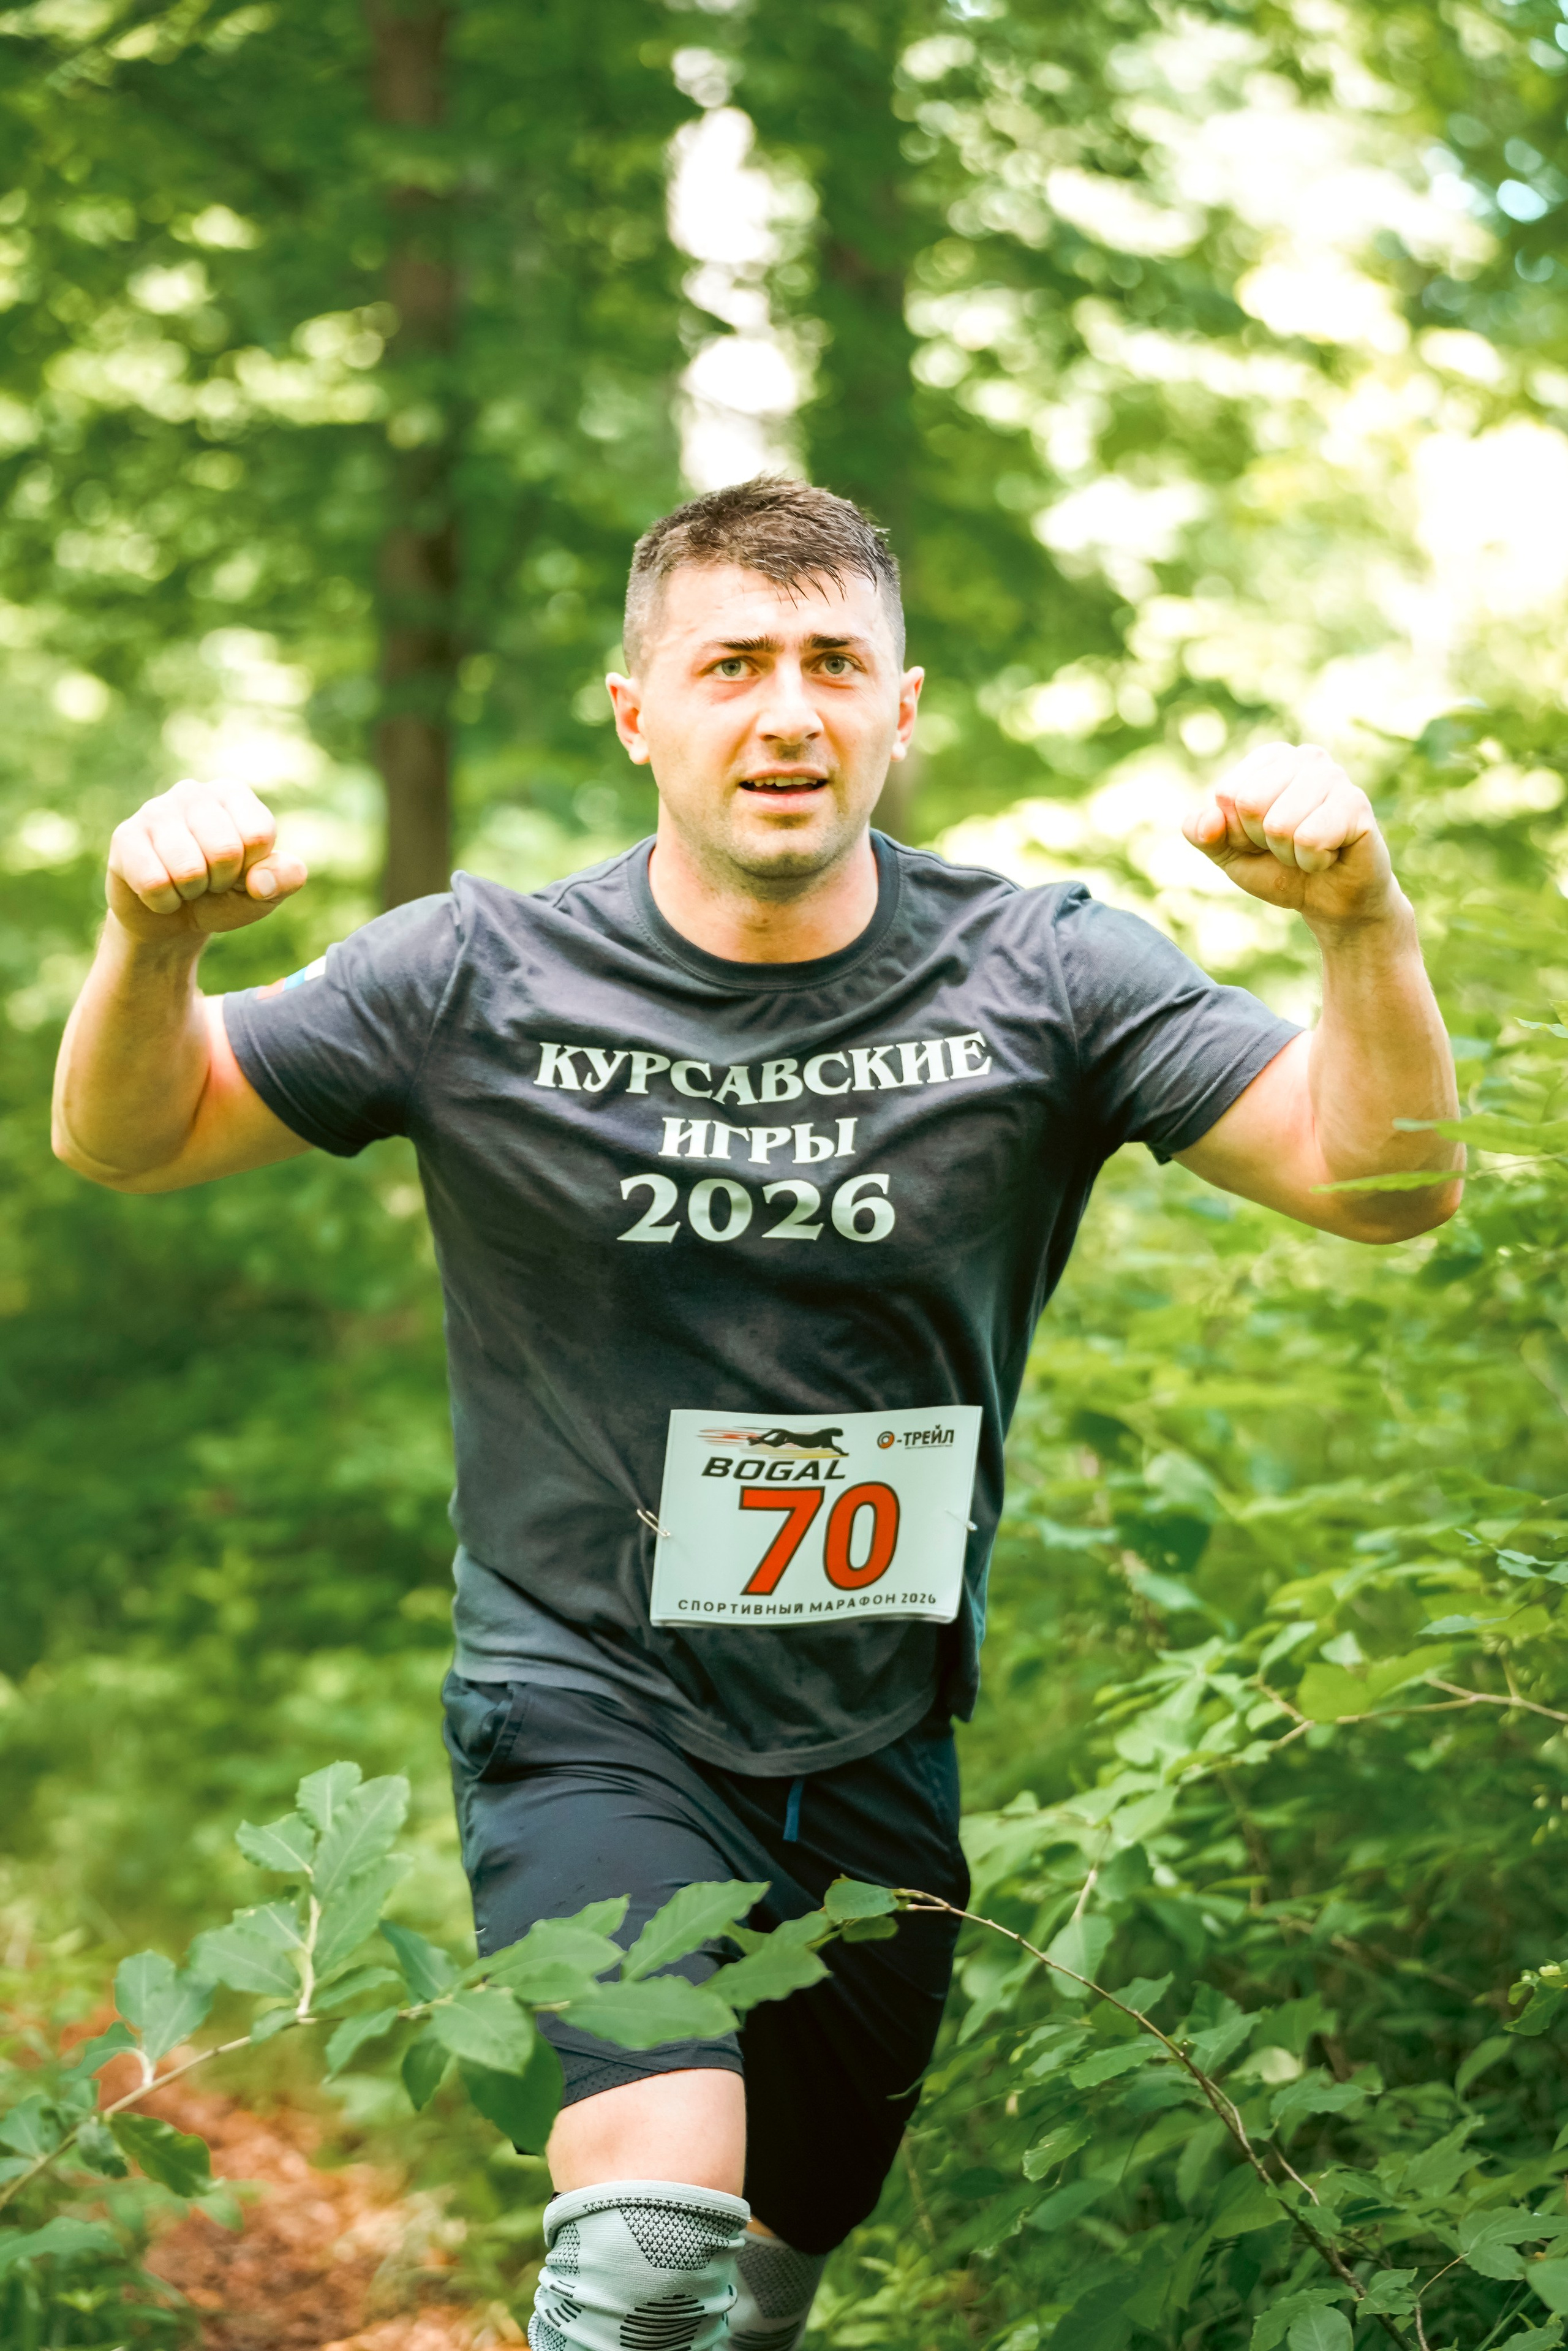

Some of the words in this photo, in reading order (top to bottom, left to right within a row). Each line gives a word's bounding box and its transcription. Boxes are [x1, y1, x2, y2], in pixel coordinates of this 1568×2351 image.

[533, 1032, 993, 1105] КУРСАВСКИЕ
[658, 1117, 858, 1164] ИГРЫ
[616, 1173, 896, 1243] 2026
[701, 1457, 846, 1481] BOGAL
[739, 1481, 900, 1596] 70
[678, 1599, 803, 1615] СПОРТИВНЫЙ
[809, 1593, 895, 1613] МАРАФОН
[901, 1593, 937, 1604] 2026
